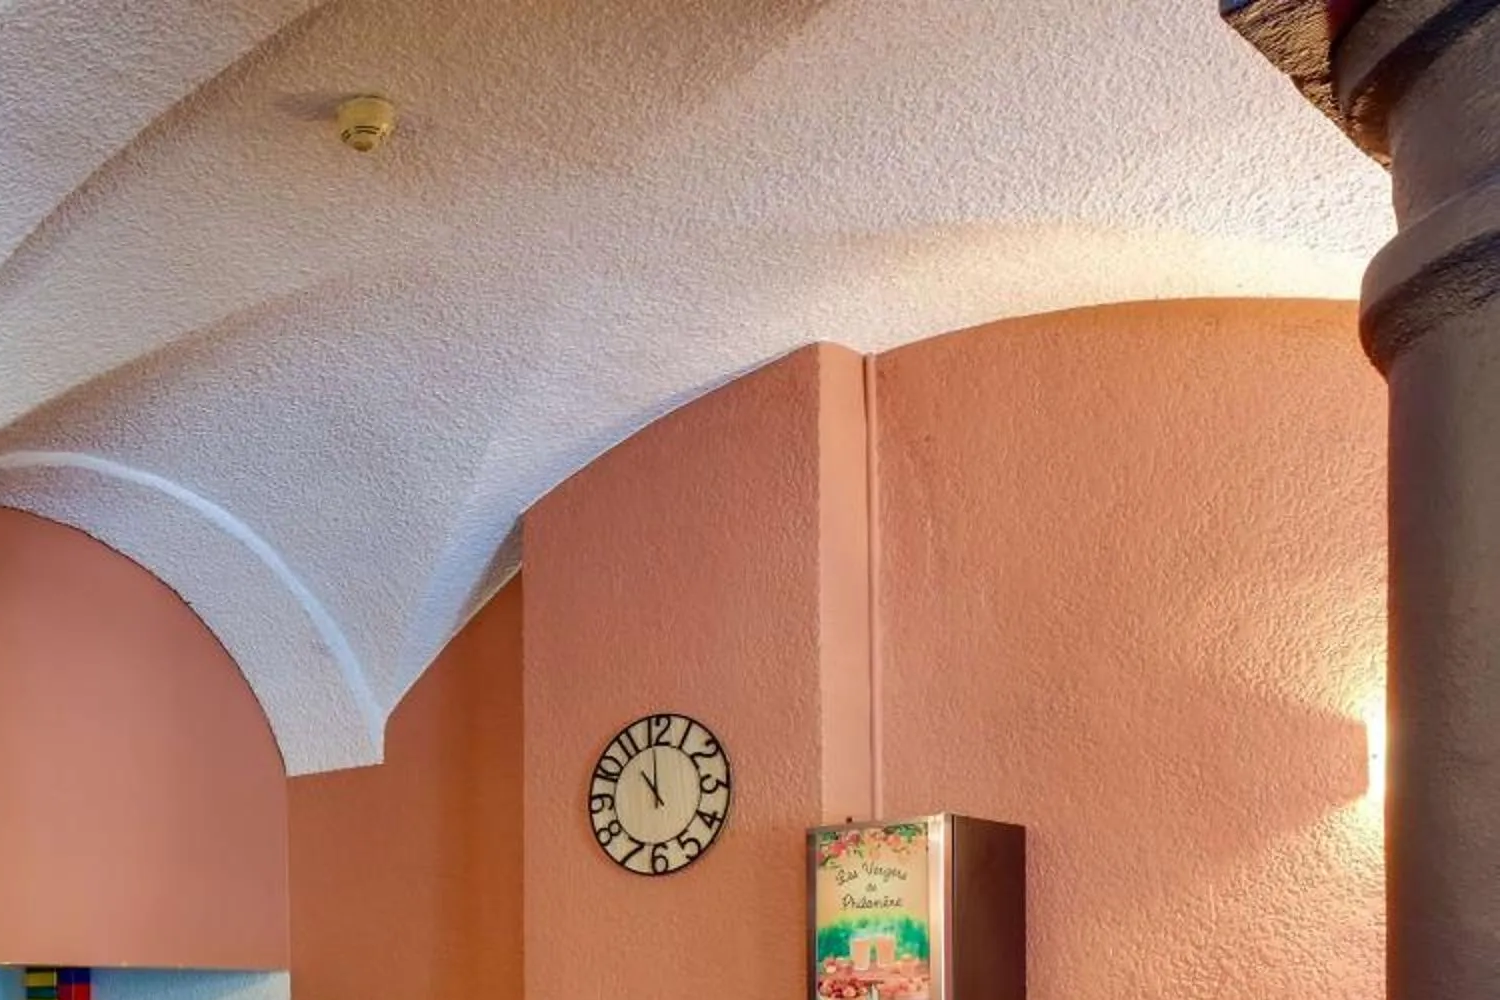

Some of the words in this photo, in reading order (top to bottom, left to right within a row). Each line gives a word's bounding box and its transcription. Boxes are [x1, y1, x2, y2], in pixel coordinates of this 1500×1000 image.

[615, 729, 641, 759] 11
[647, 716, 671, 748] 12
[679, 720, 694, 749] 1
[690, 738, 720, 770] 2
[596, 755, 624, 783] 10
[700, 773, 729, 794] 3
[590, 793, 615, 814] 9
[596, 820, 622, 847] 8
[696, 810, 723, 829] 4
[620, 835, 646, 866] 7
[652, 842, 669, 873] 6
[677, 829, 702, 862] 5
[861, 861, 907, 883] Vergers
